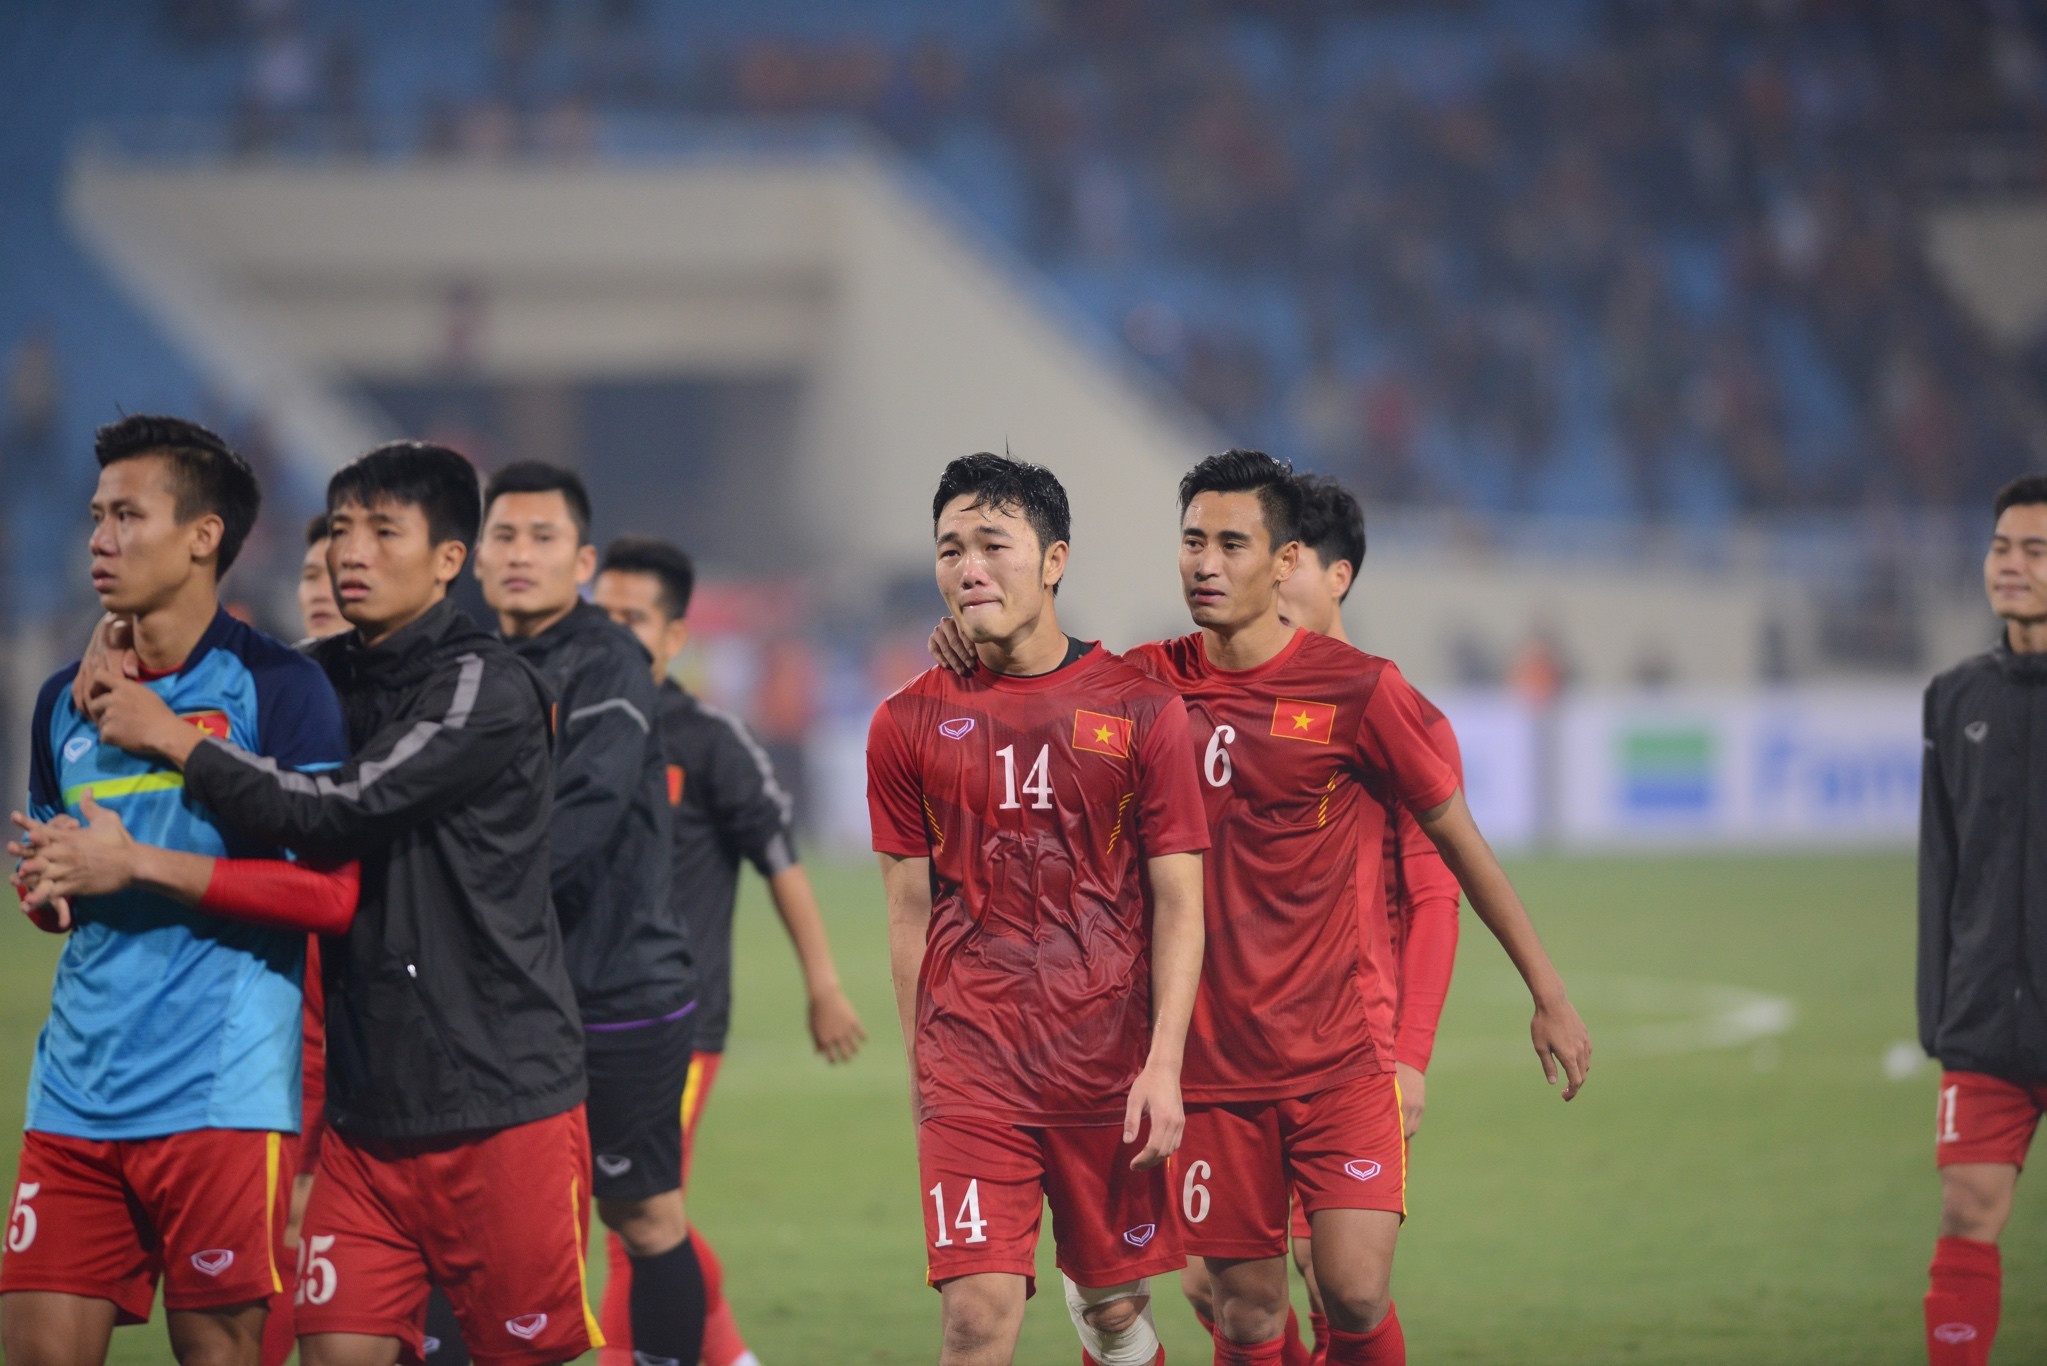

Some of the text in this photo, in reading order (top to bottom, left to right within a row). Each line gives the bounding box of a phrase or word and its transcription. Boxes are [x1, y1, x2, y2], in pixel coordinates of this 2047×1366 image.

[995, 743, 1054, 810] 14
[1203, 724, 1236, 788] 6
[1936, 1084, 1959, 1142] 1
[2, 1181, 40, 1253] 5
[929, 1178, 988, 1248] 14
[1182, 1159, 1212, 1224] 6
